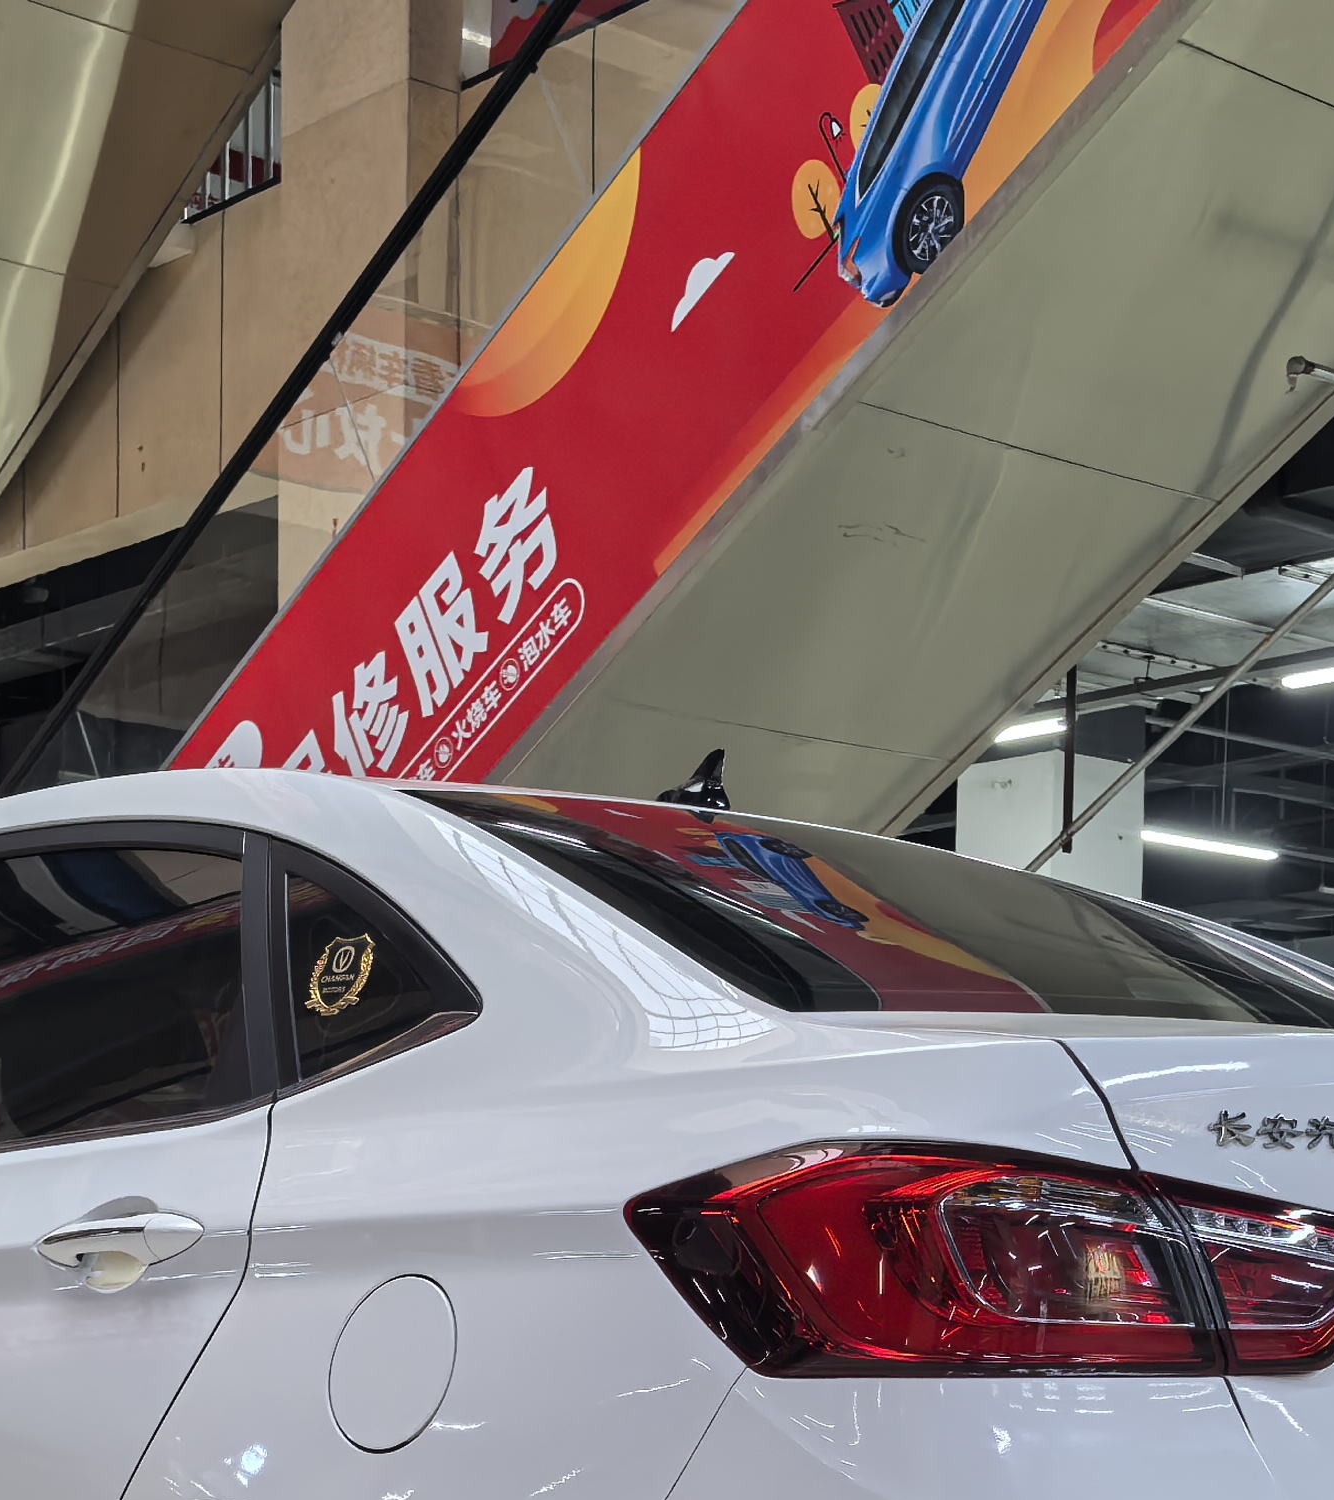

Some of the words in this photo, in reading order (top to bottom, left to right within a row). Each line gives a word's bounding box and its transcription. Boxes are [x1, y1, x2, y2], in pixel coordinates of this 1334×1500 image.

[451, 680, 503, 751] 火烧车
[517, 597, 573, 672] 泡水车
